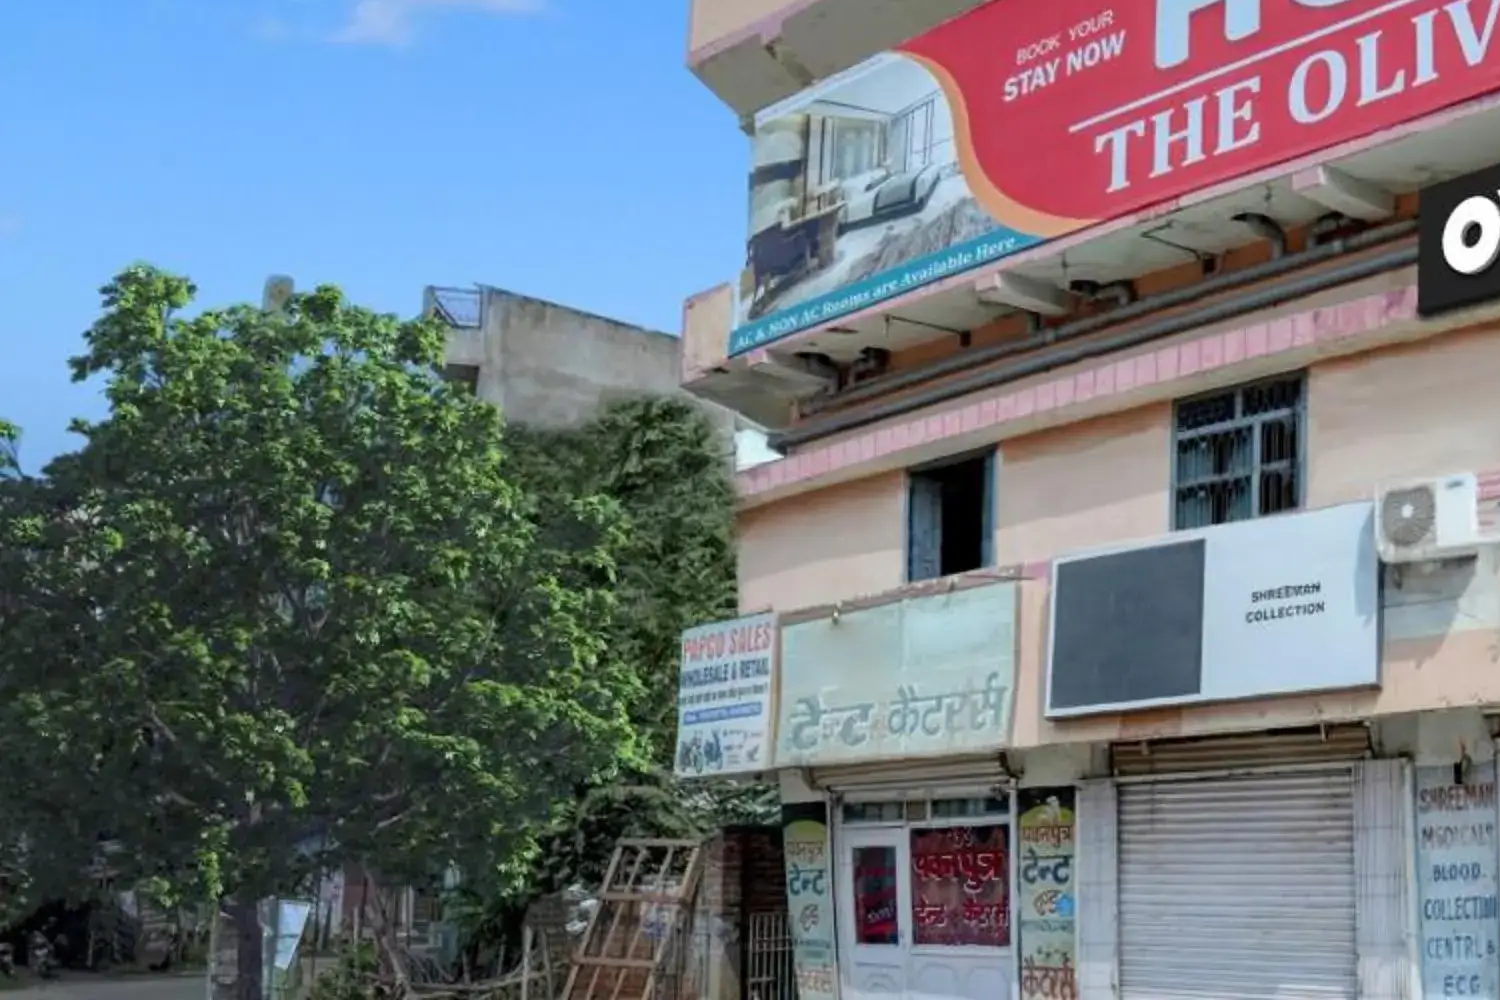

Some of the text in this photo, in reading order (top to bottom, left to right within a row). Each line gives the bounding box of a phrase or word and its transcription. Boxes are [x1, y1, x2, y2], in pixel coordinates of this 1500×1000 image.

[1003, 29, 1127, 102] STAY NOW
[1016, 8, 1114, 66] BOOK YOUR
[1095, 76, 1262, 193] THE
[822, 291, 871, 320] Rooms
[899, 253, 972, 291] Available
[975, 236, 1018, 262] Here
[1245, 601, 1326, 623] COLLECTION
[1433, 862, 1482, 883] BLOOD
[1443, 974, 1482, 997] ECG
